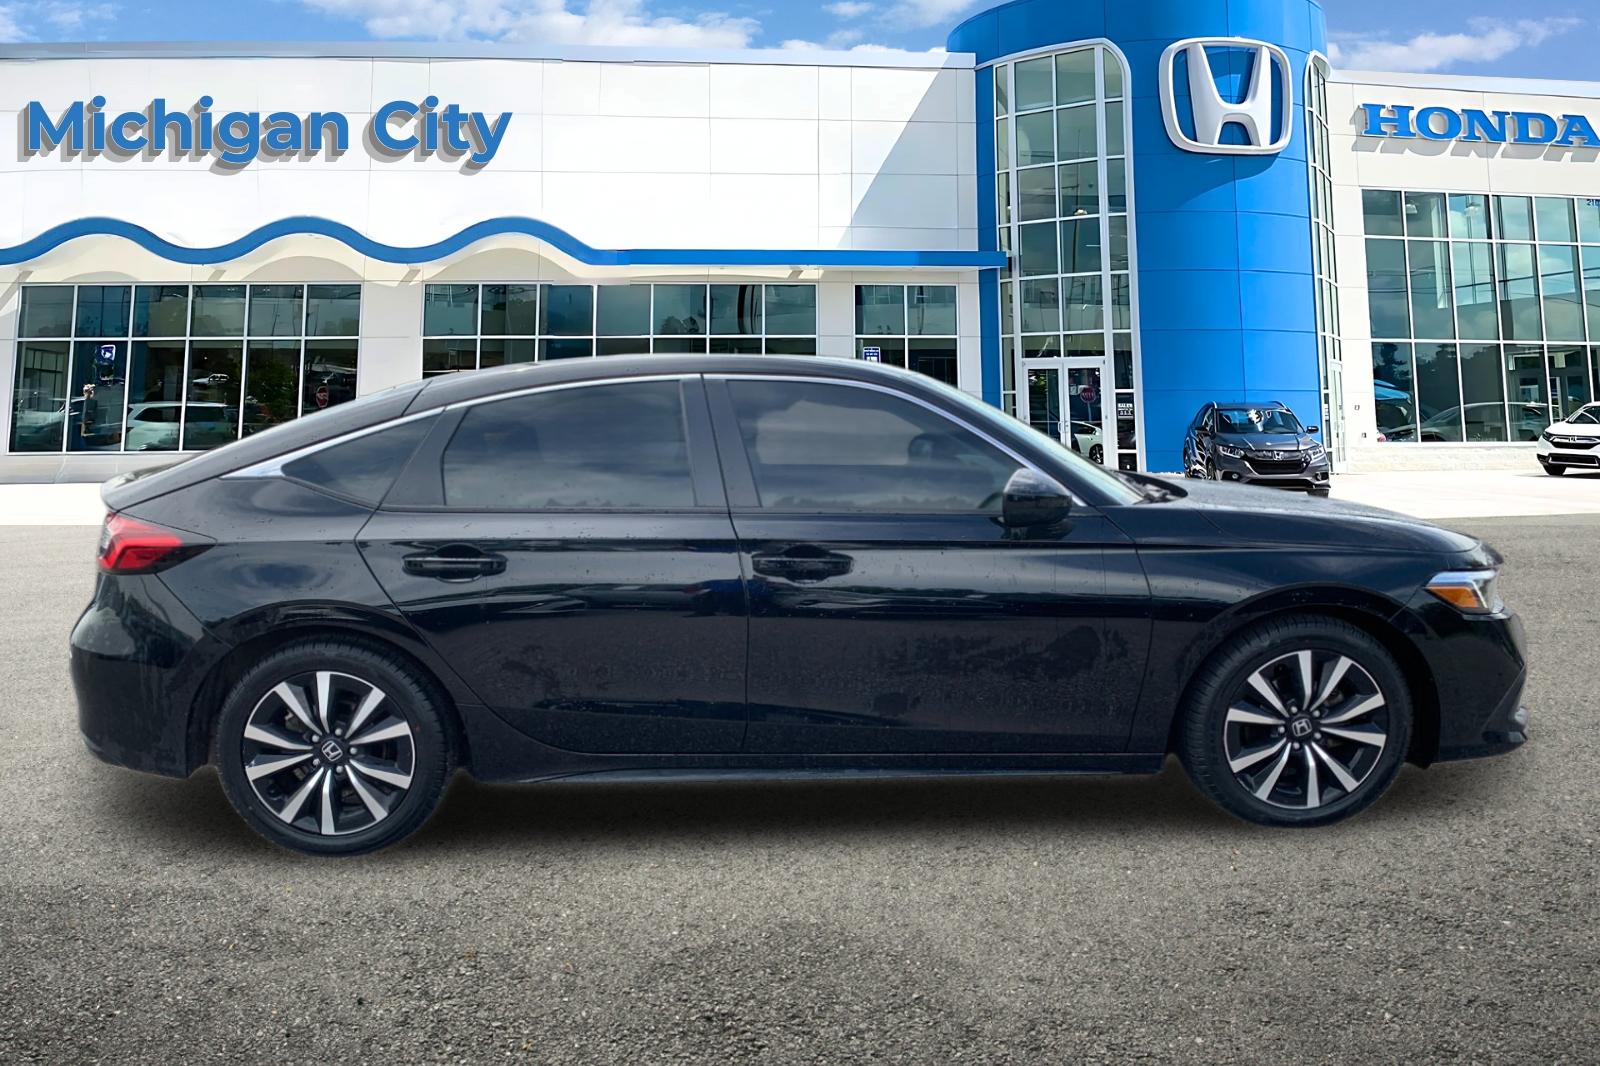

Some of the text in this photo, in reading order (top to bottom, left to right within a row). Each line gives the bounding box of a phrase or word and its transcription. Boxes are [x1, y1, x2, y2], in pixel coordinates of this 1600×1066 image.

[28, 95, 514, 163] Michigan City
[1361, 103, 1600, 148] HONDA
